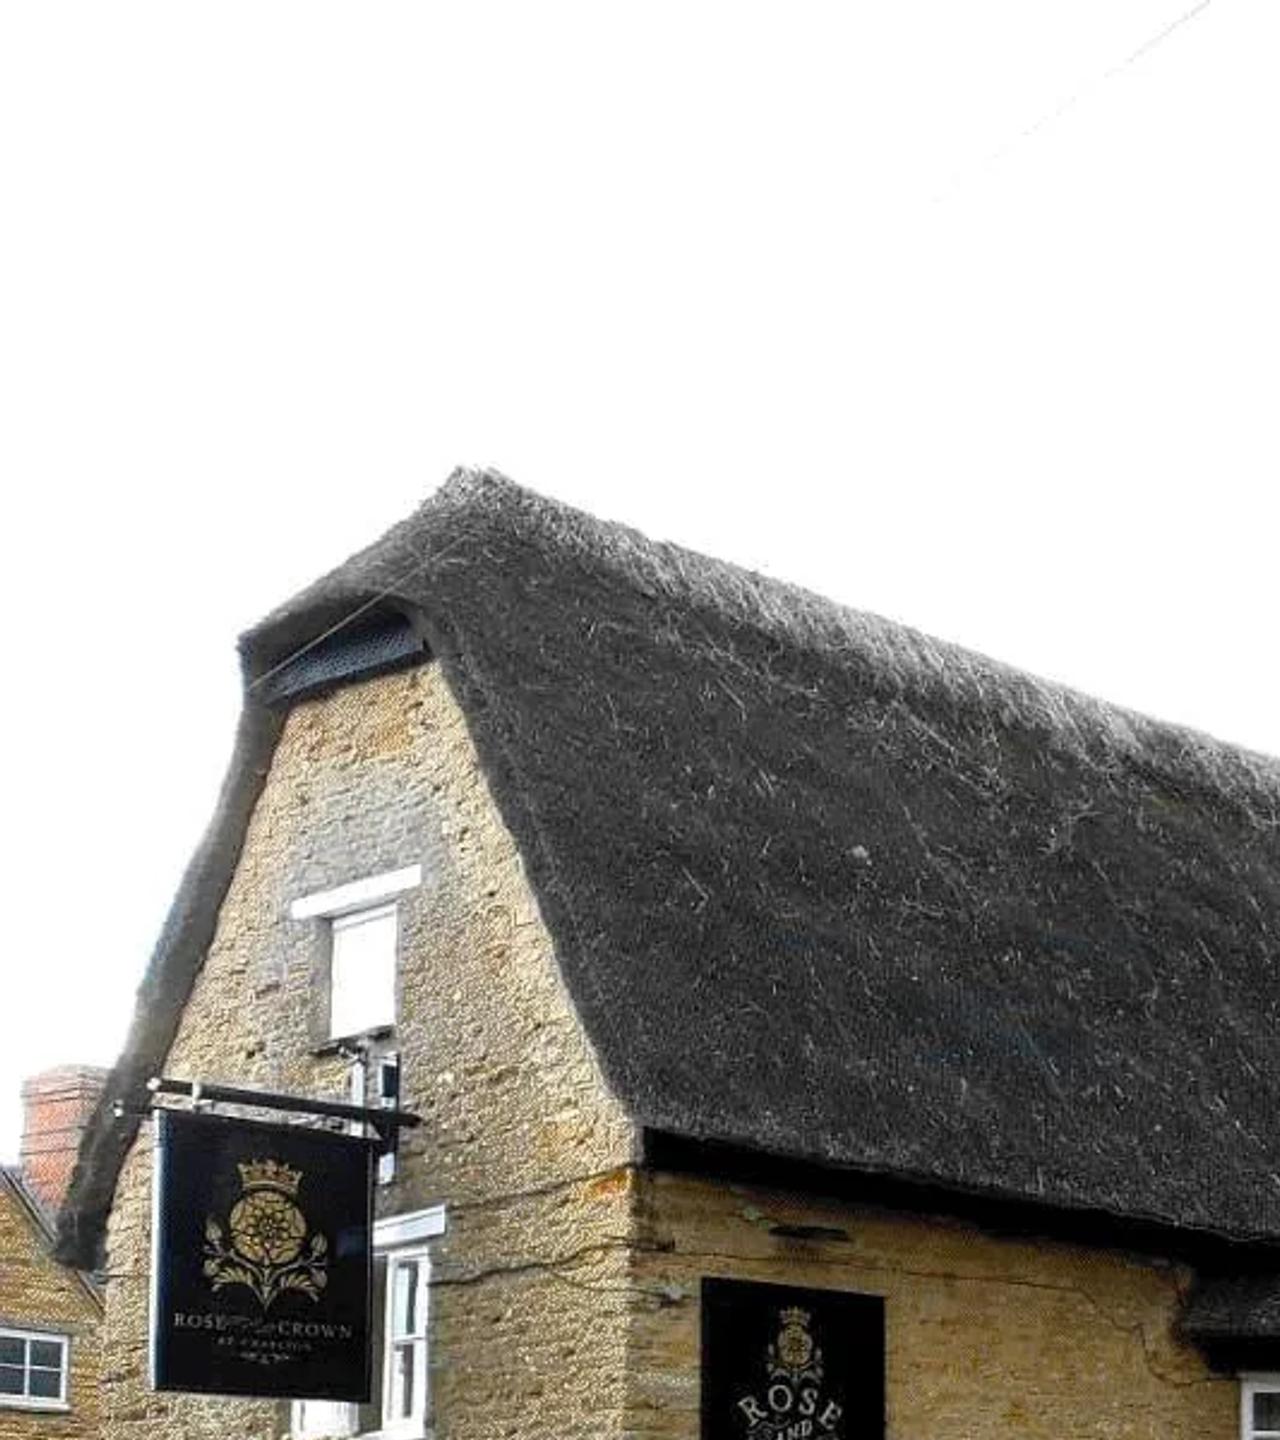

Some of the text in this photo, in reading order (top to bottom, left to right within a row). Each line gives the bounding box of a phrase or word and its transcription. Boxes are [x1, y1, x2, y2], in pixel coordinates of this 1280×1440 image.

[173, 1312, 226, 1331] ROSE
[277, 1319, 352, 1339] CROWN
[737, 1384, 843, 1430] ROSE
